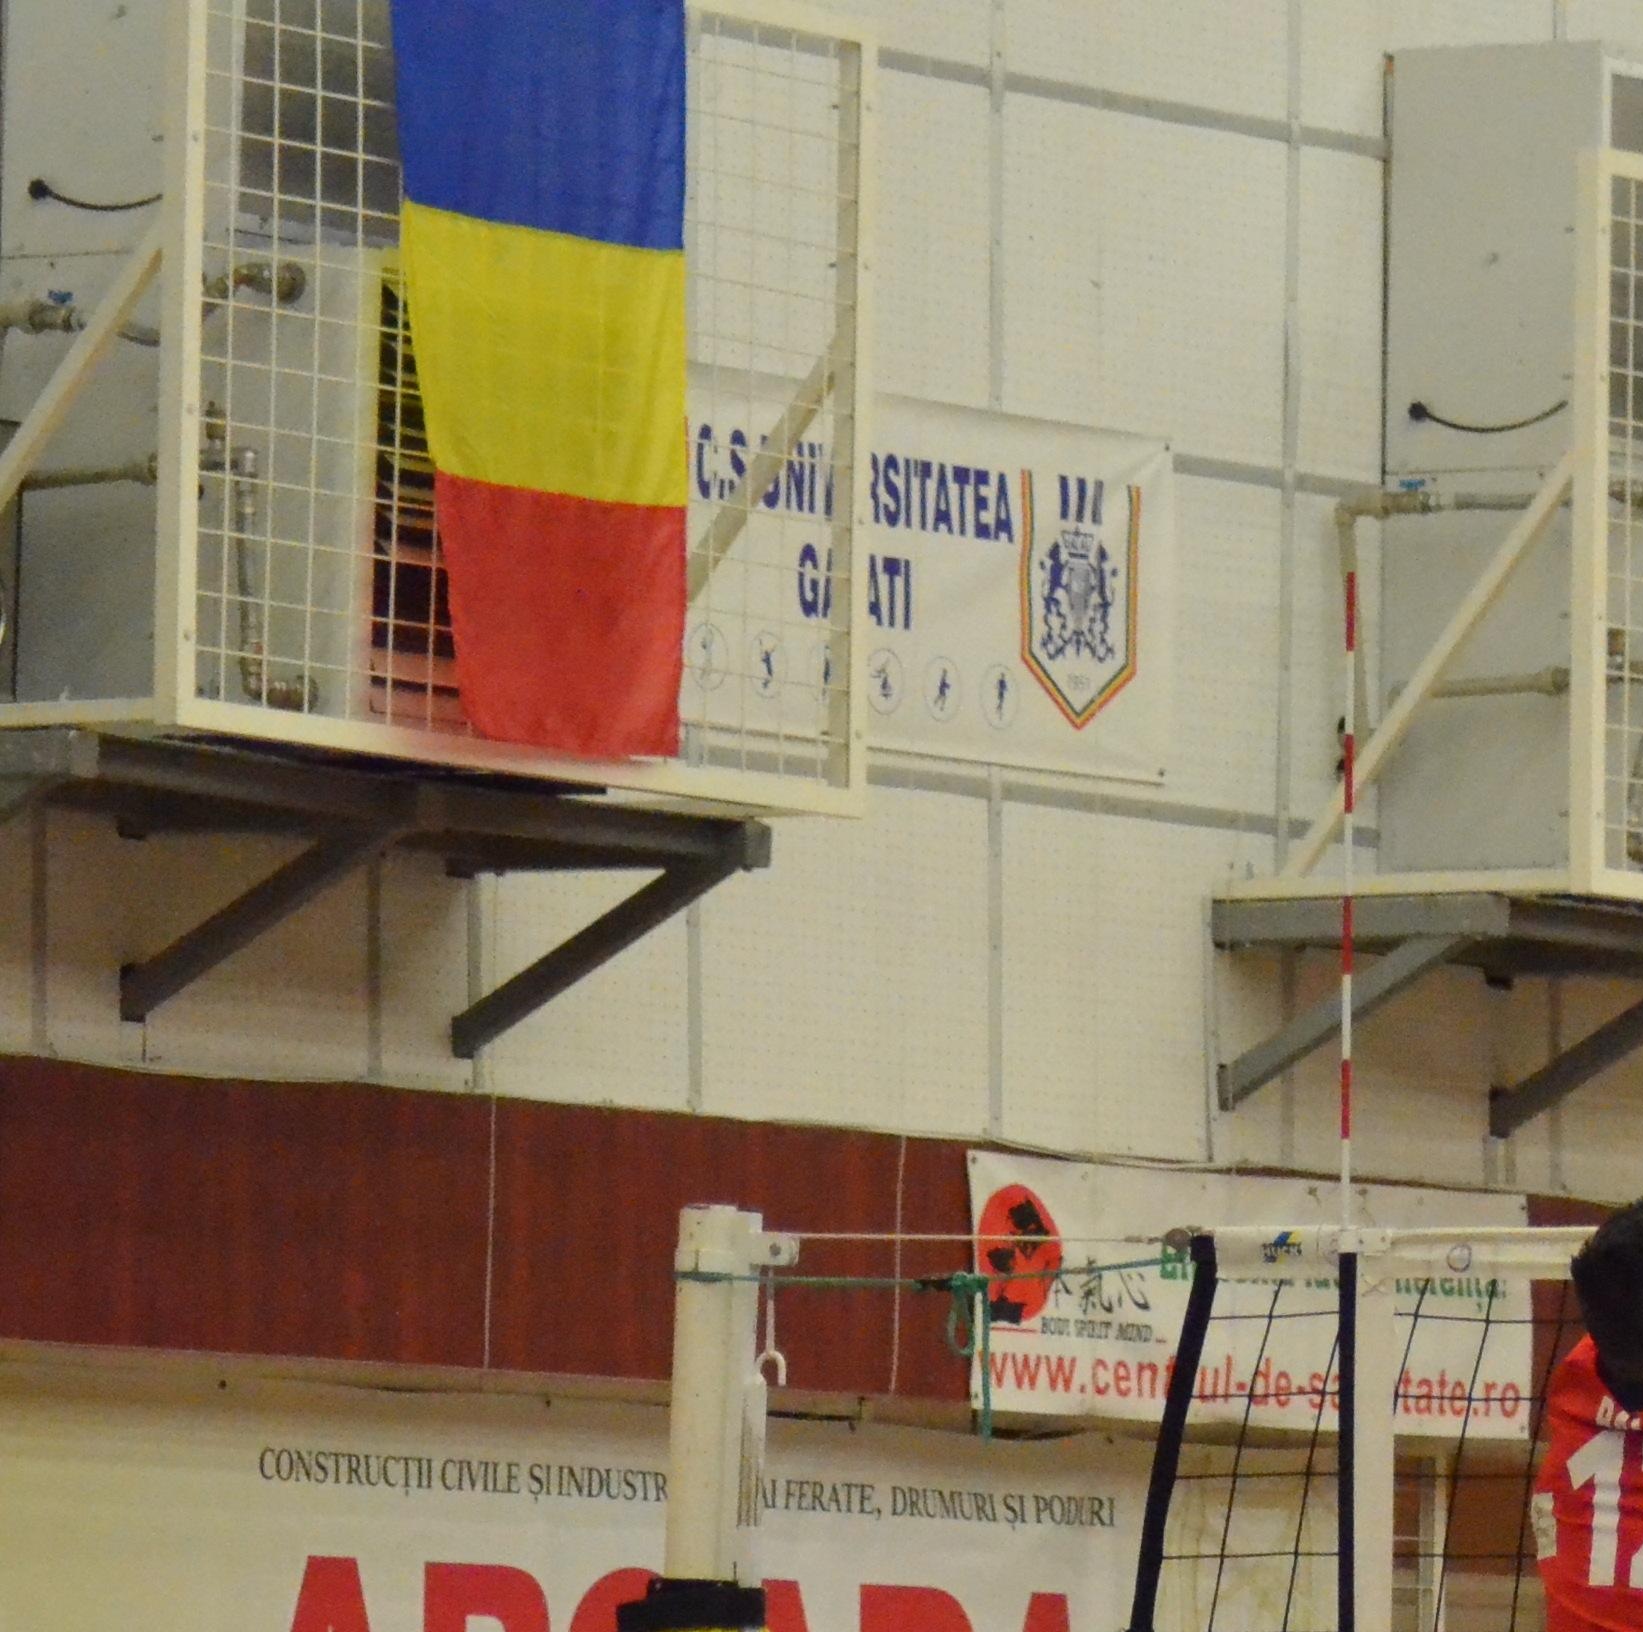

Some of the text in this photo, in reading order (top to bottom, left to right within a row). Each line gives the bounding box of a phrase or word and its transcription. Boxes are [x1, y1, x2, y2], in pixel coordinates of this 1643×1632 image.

[440, 1457, 521, 1496] CIVILE
[890, 1485, 998, 1524] DRUMURI
[1032, 1494, 1116, 1528] PODURI
